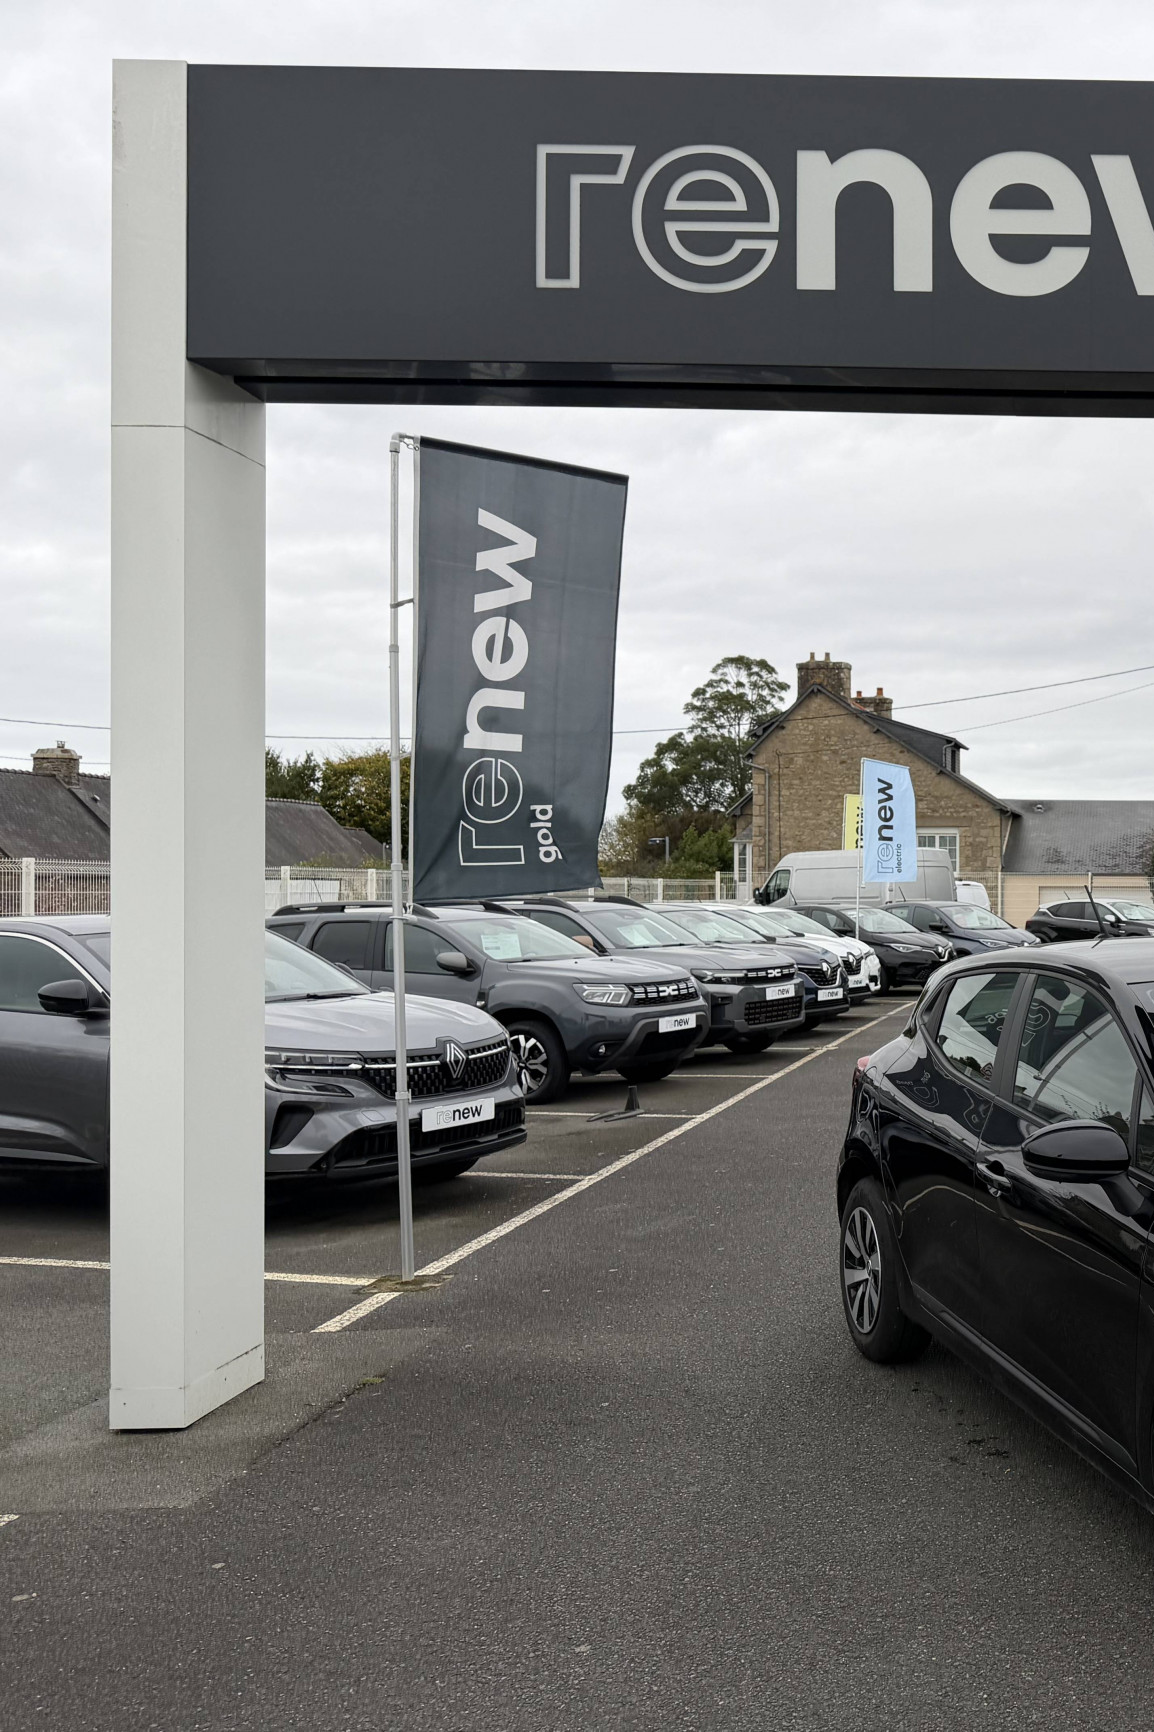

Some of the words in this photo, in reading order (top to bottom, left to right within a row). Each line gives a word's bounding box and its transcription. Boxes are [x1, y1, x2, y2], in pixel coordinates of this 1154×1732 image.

[458, 507, 537, 866] renew
[529, 804, 563, 864] gold
[876, 777, 894, 874] renew
[895, 843, 903, 874] electric
[436, 1104, 483, 1125] renew
